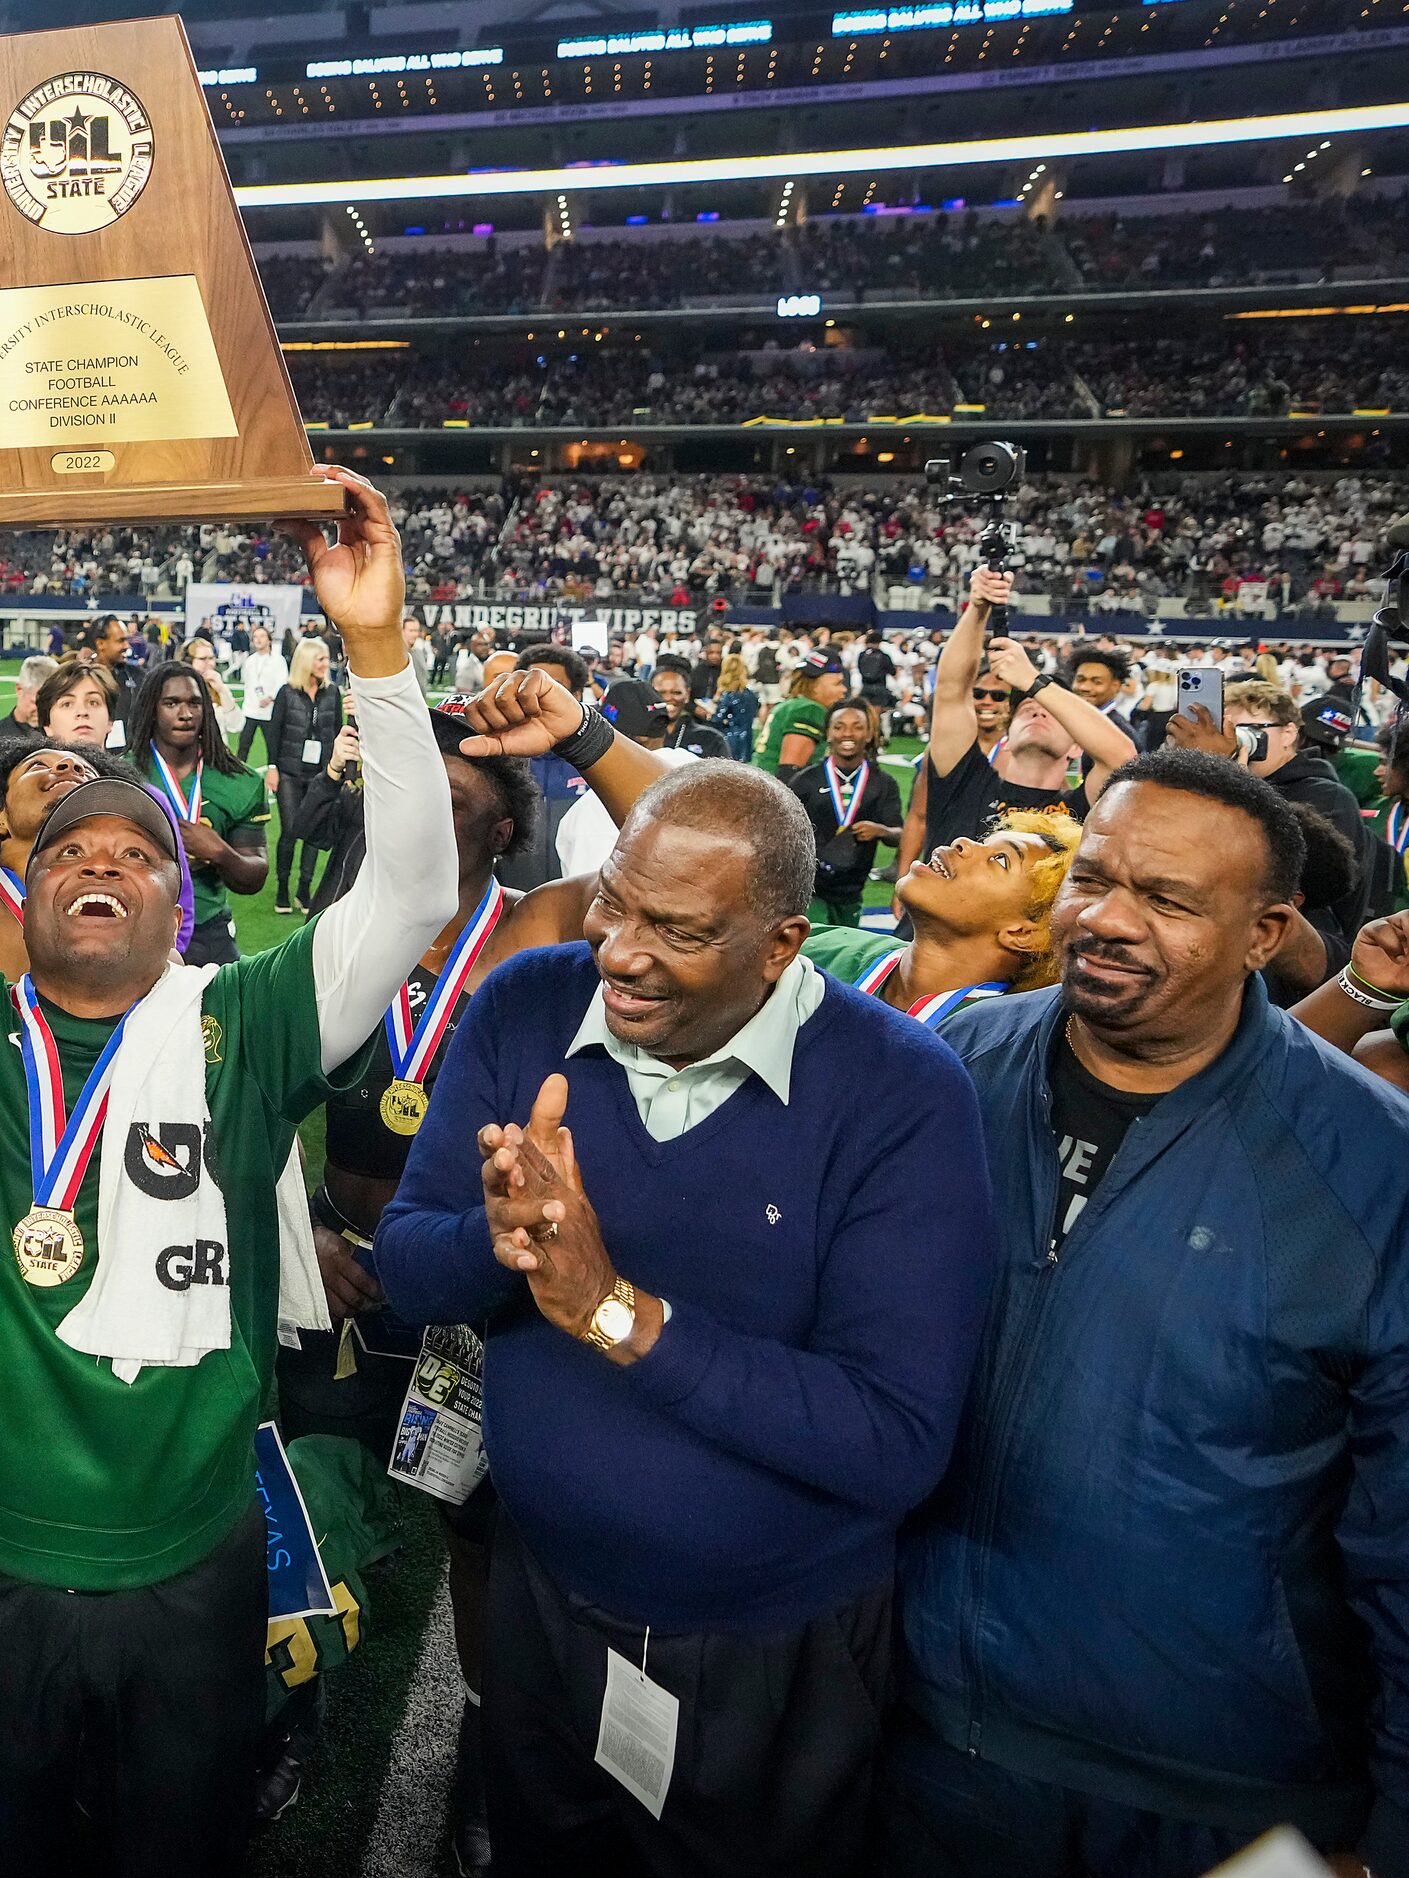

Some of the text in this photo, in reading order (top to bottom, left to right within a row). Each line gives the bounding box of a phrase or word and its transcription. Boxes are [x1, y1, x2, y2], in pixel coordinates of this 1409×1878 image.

[19, 74, 149, 132] INTERSCHOLASTIC
[29, 105, 122, 180] UIL
[46, 177, 106, 199] STATE
[34, 303, 151, 334] INTERSCHOLASTIC
[149, 329, 190, 375] LEAGUE
[25, 355, 139, 374] STATE CHAMPION
[48, 376, 116, 390] FOOTBALL
[9, 392, 158, 411] CONFERENCE AAAAAA
[50, 413, 116, 428] DIVISION II
[66, 456, 101, 469] 2022
[423, 604, 587, 630] VANDEGRIT
[596, 607, 697, 634] VIPERS
[1342, 981, 1372, 1005] BLACK
[29, 1259, 59, 1272] STATE
[155, 1239, 229, 1291] GR
[452, 1400, 469, 1414] STATE
[455, 1388, 472, 1401] YOUR
[469, 1396, 483, 1408] 2022
